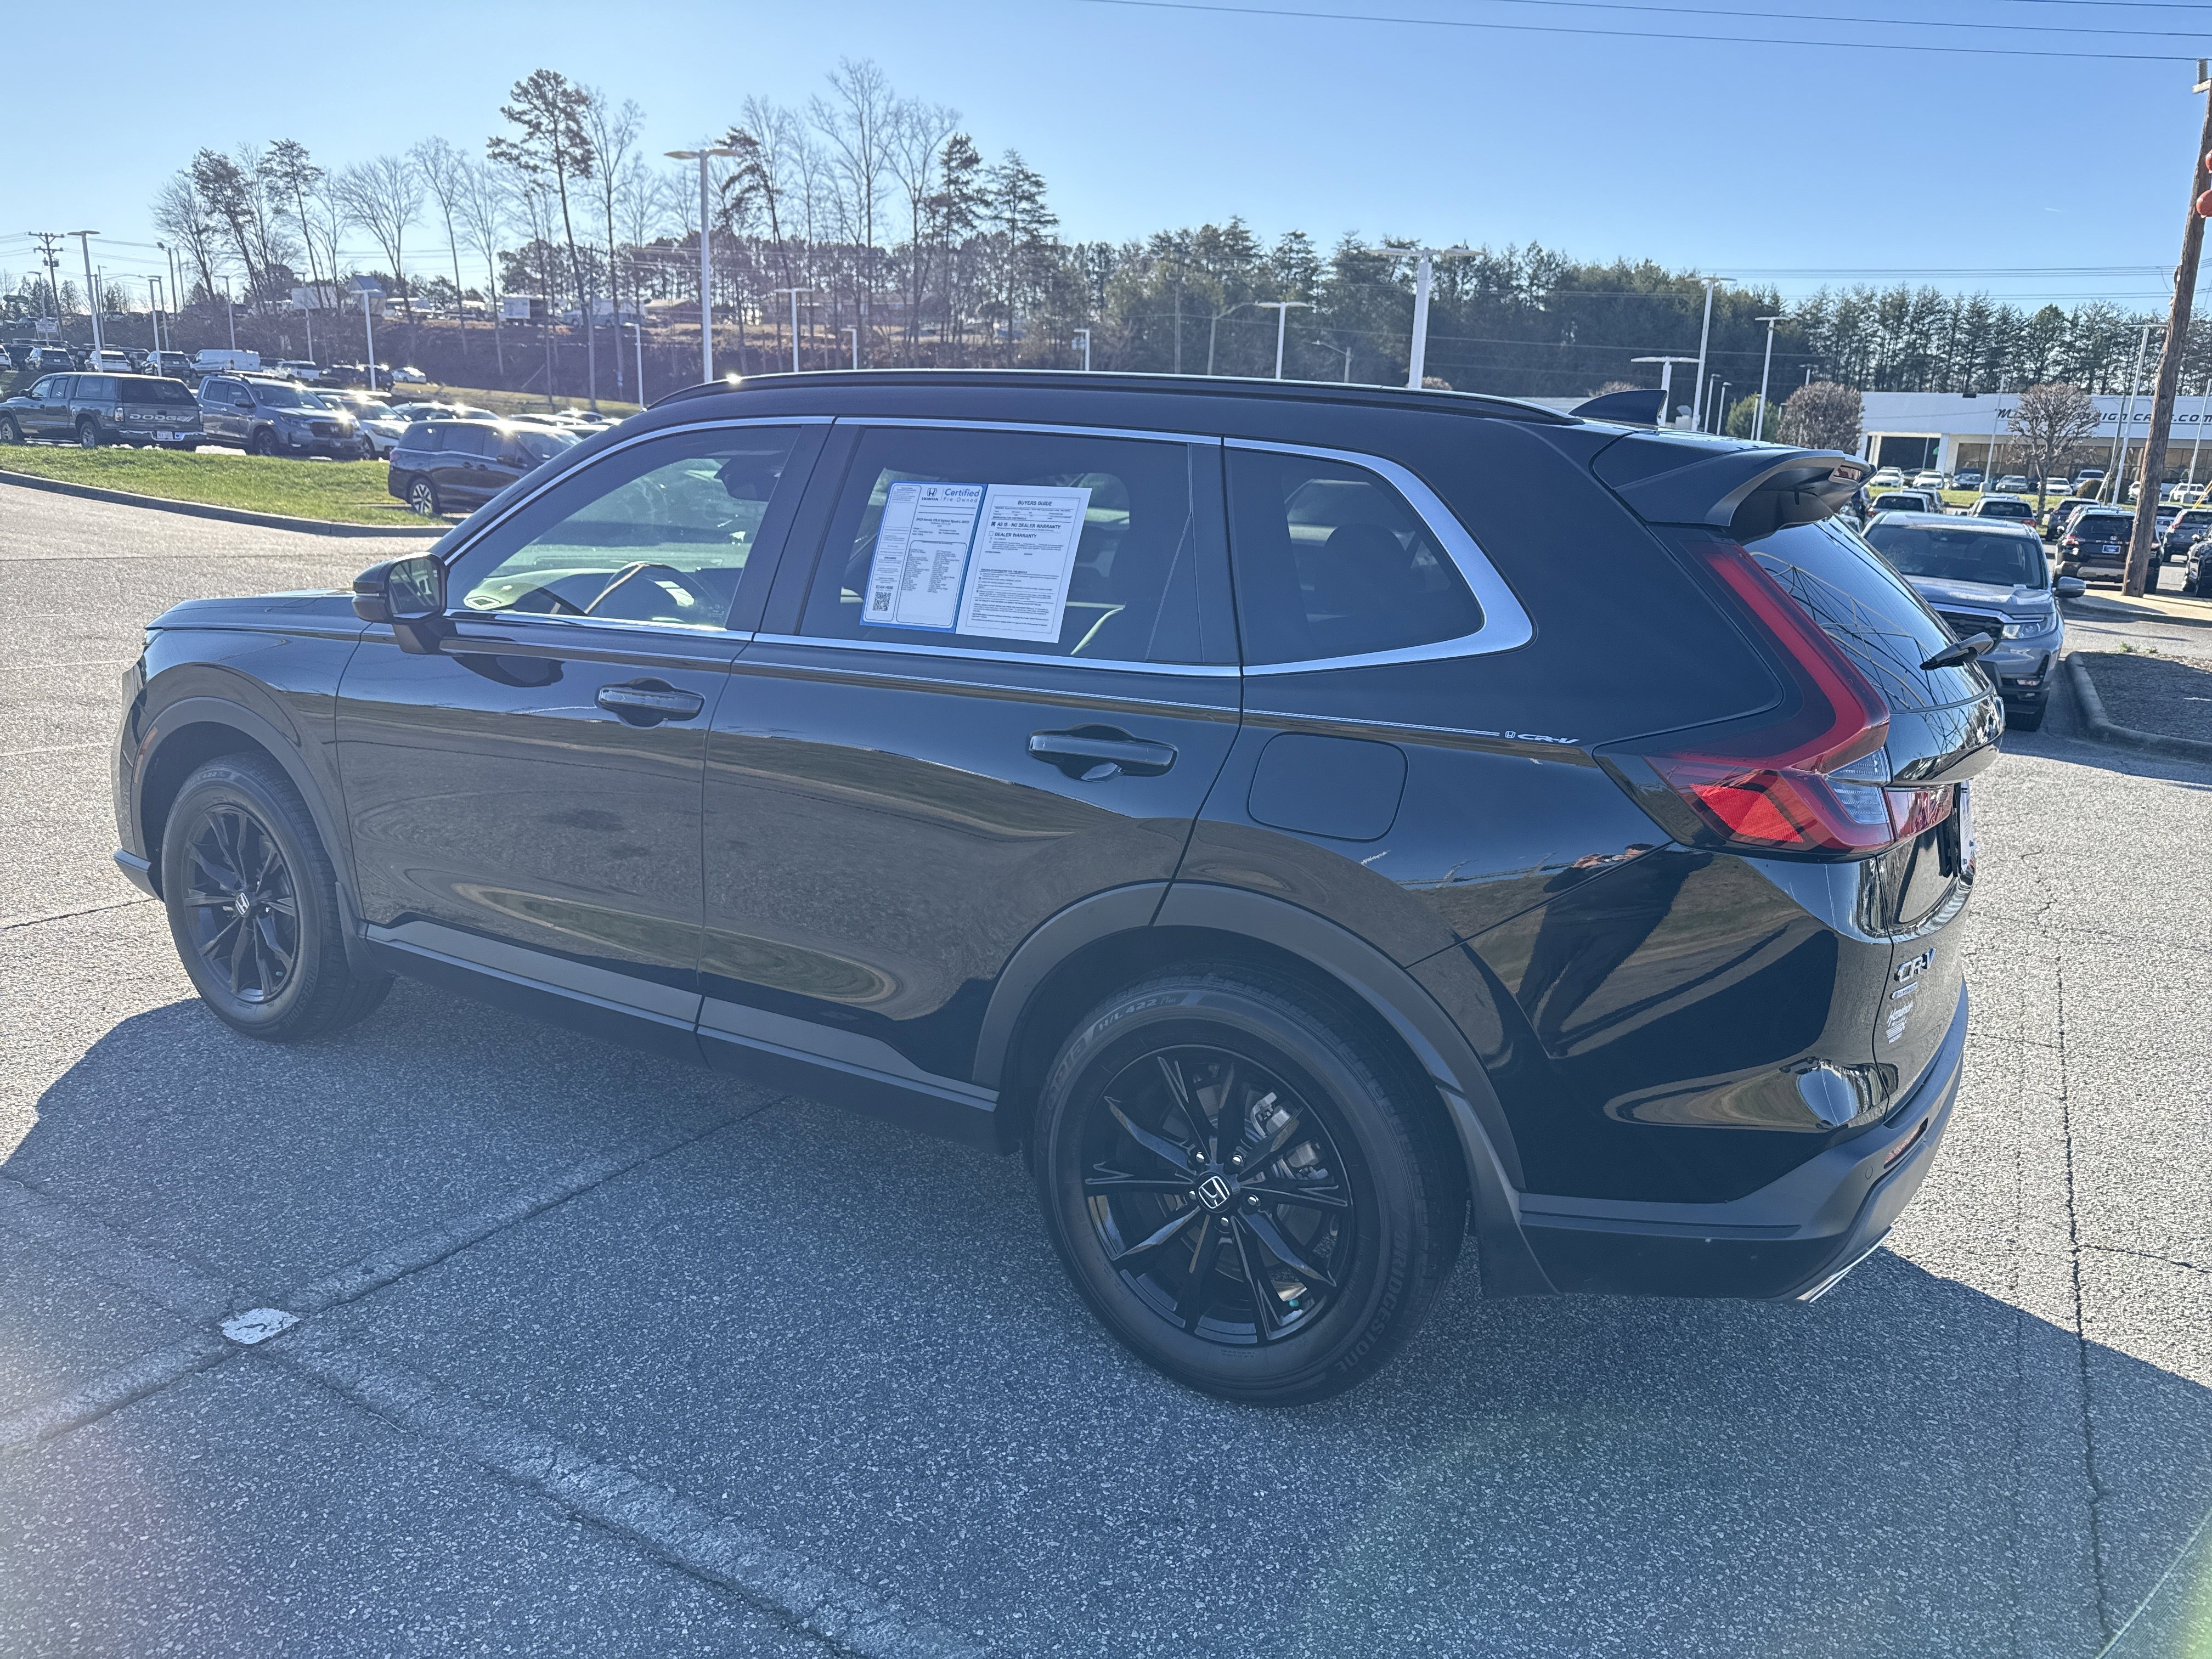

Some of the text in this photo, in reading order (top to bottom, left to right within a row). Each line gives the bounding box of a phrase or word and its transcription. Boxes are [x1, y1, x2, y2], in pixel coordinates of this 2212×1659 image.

[129, 414, 187, 422] DODGE
[945, 488, 980, 497] Certified
[1517, 733, 1579, 744] CR-V
[1898, 948, 1936, 983] CR-V
[1125, 998, 1158, 1014] 422
[1334, 1229, 1408, 1373] BRIDGESTONE
